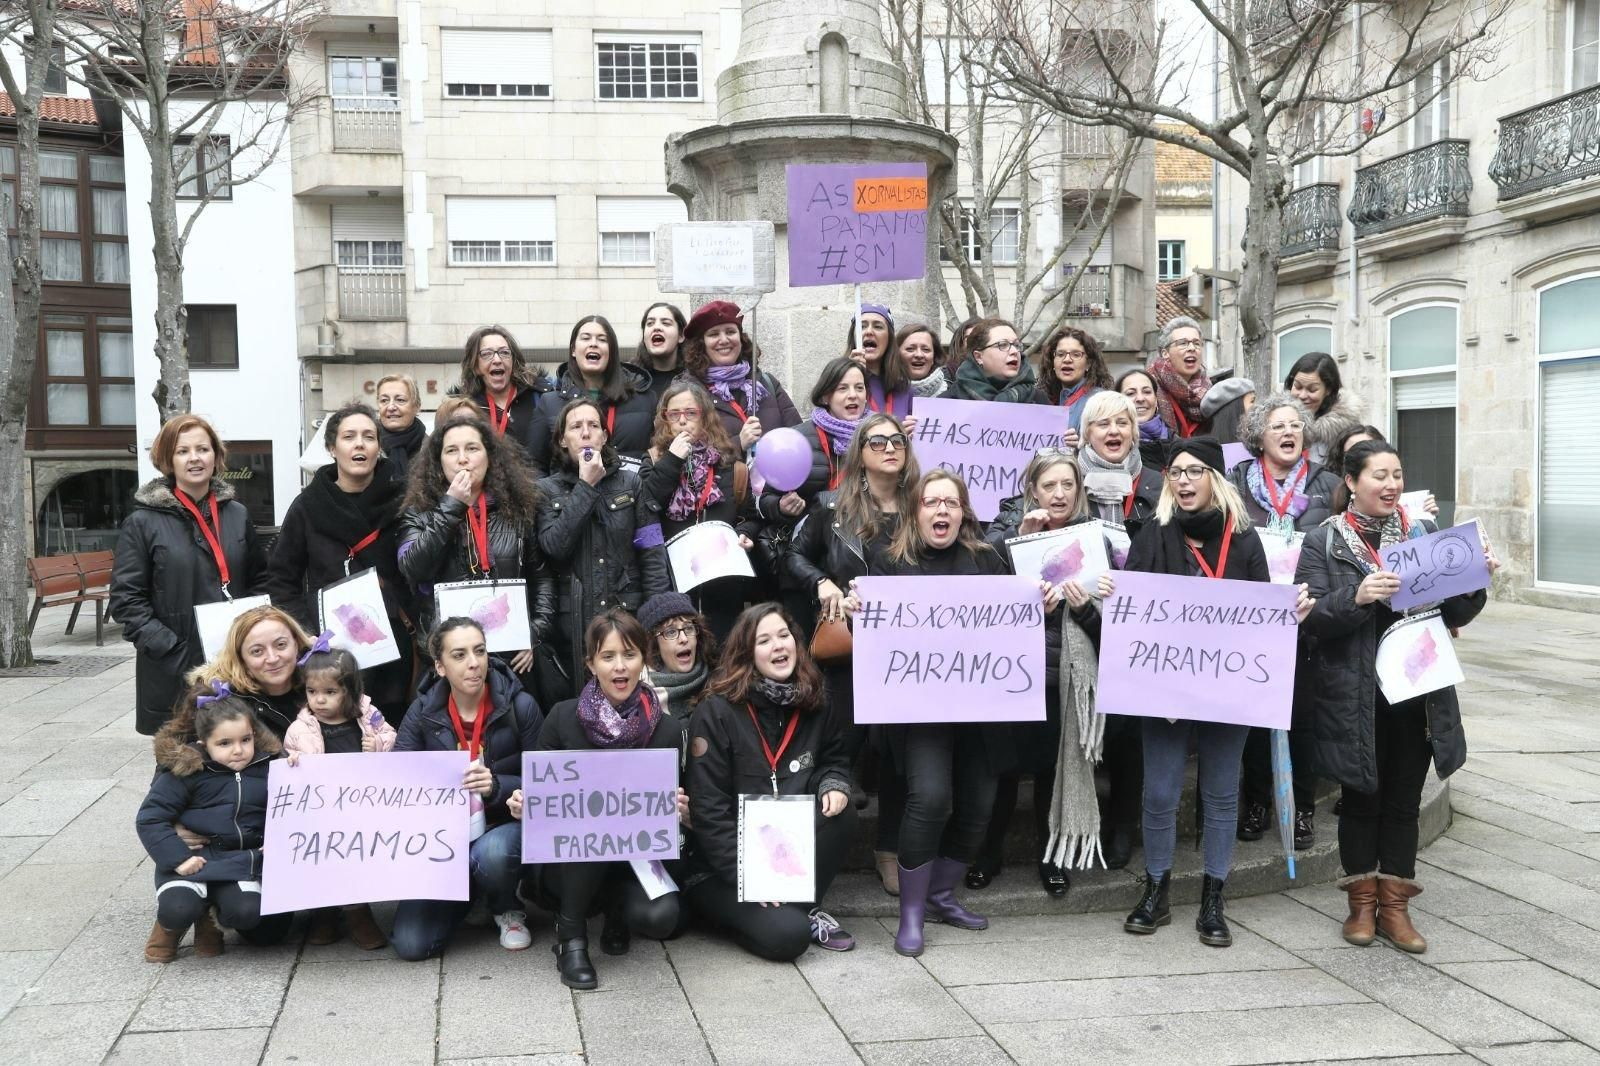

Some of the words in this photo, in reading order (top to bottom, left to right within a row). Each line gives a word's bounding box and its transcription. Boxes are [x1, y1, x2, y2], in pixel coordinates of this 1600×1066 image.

[806, 181, 849, 212] AS
[857, 184, 927, 205] XORNALISTAS
[820, 211, 927, 242] PARAMOS
[817, 241, 896, 278] #8M
[938, 461, 1027, 497] ARAM
[920, 602, 1043, 630] XORNALISTAS
[1172, 602, 1299, 627] XORNALISTAS
[884, 650, 1033, 694] PARAMOS
[1128, 640, 1270, 683] PARAMOS
[531, 760, 580, 783] LAS
[332, 785, 468, 812] XORNALISTAS
[288, 829, 455, 866] PARAMOS
[553, 829, 673, 859] PARAMOS
